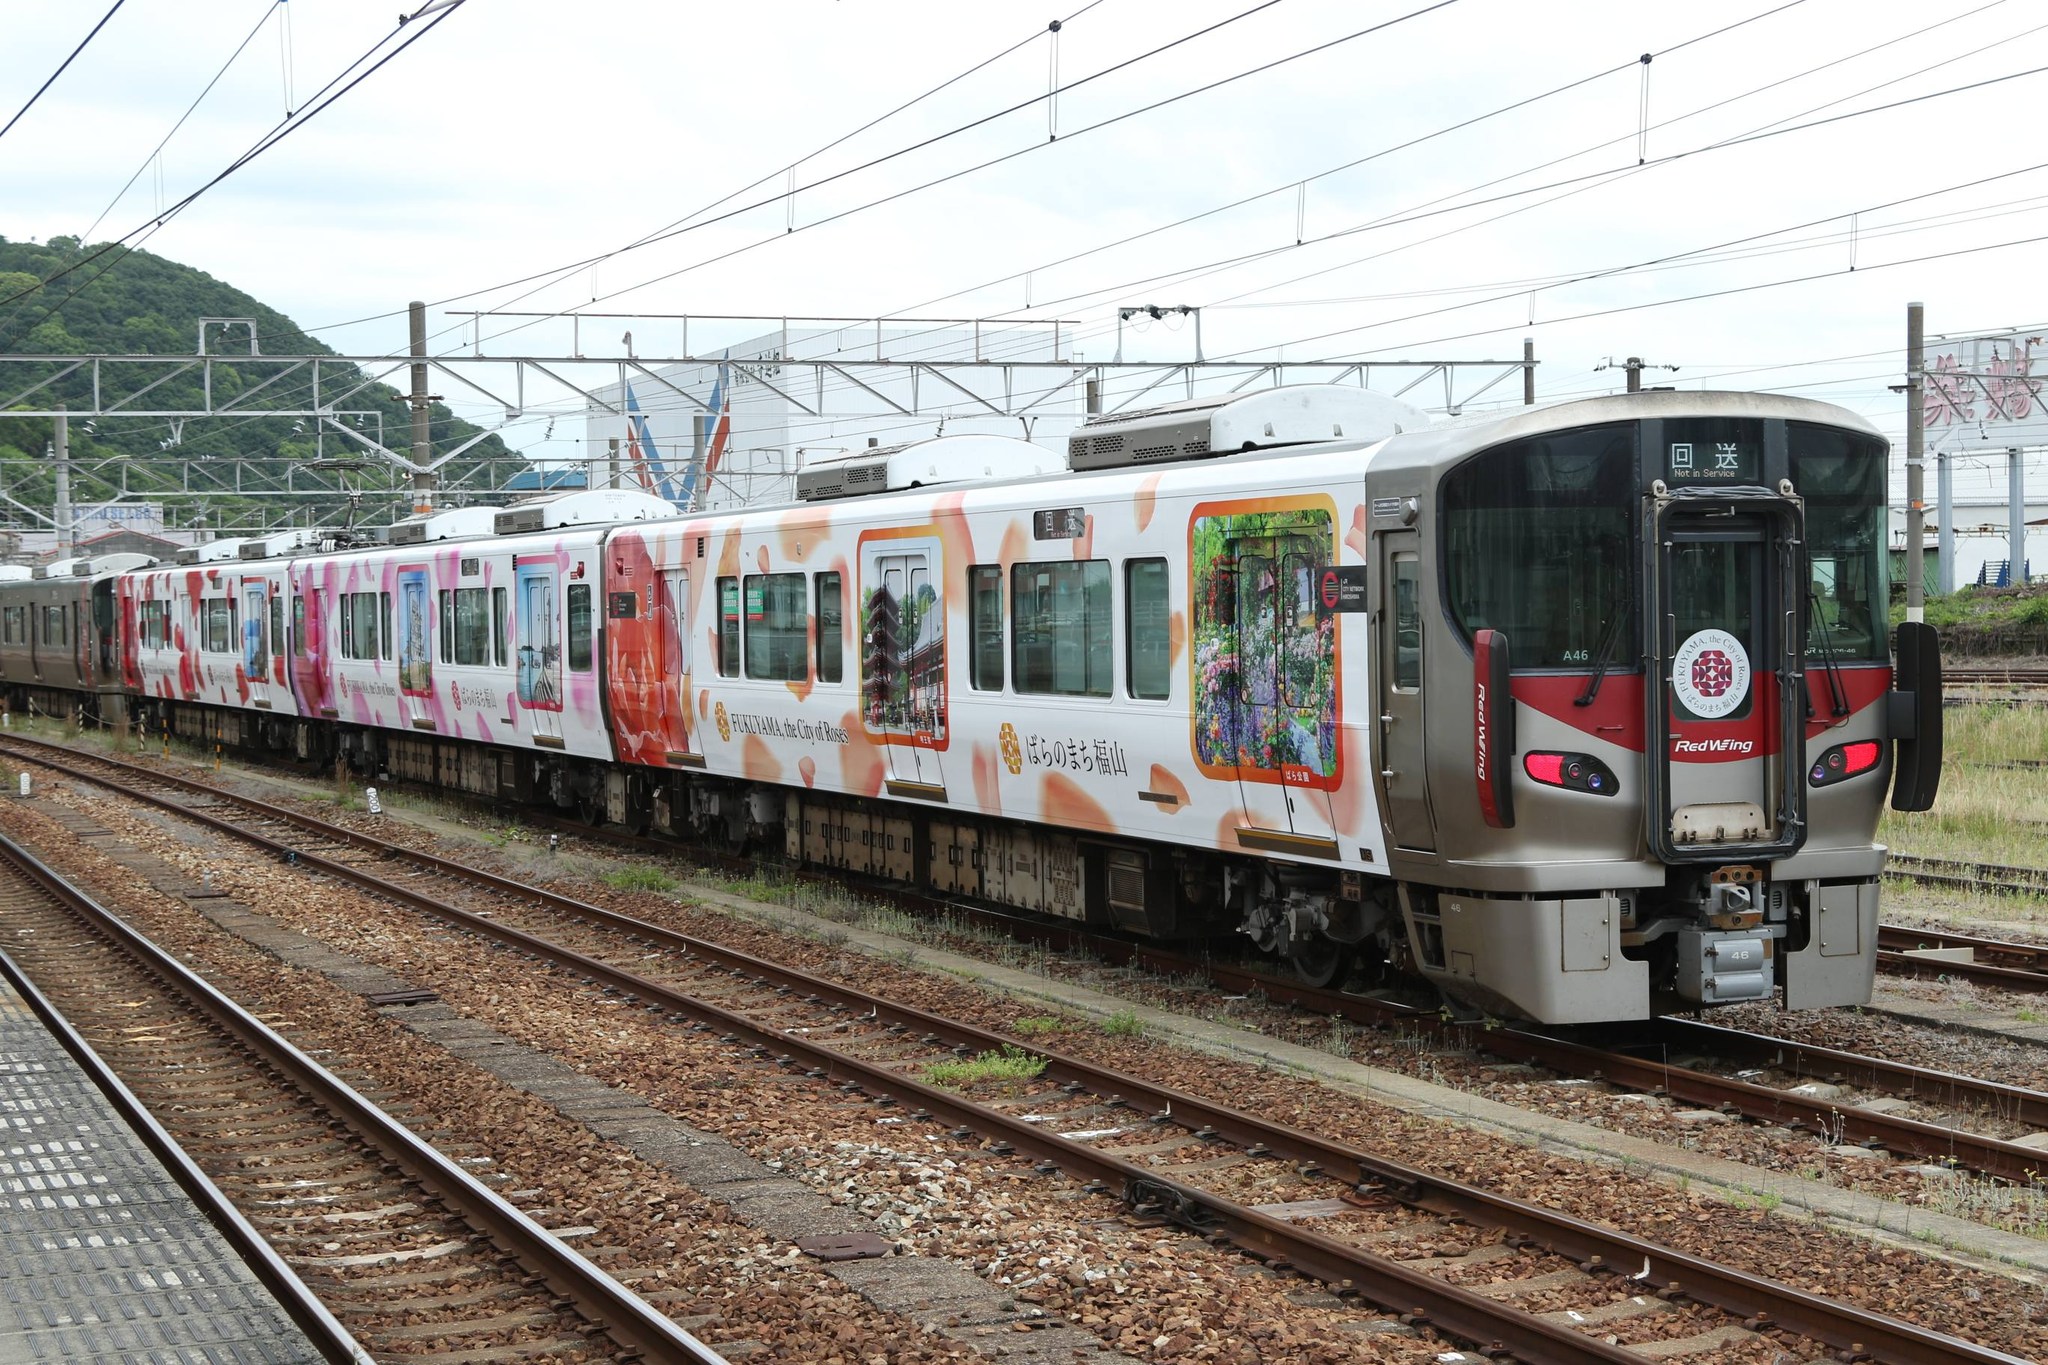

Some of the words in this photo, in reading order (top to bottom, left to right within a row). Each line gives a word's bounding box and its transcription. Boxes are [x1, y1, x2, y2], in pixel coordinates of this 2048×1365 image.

[1672, 443, 1738, 469] 回送
[1674, 469, 1690, 477] Not
[1693, 469, 1700, 477] in
[1703, 469, 1735, 477] Service
[1709, 635, 1721, 643] the
[1723, 639, 1737, 654] City
[1563, 650, 1589, 661] A46
[1735, 654, 1742, 663] of
[1736, 665, 1745, 691] Roses
[784, 718, 797, 738] the
[797, 719, 815, 745] City
[815, 720, 824, 741] of
[823, 722, 849, 743] Roses
[1025, 733, 1128, 776] ばらのまち福山
[1451, 903, 1461, 912] 46
[1731, 951, 1749, 960] 46
